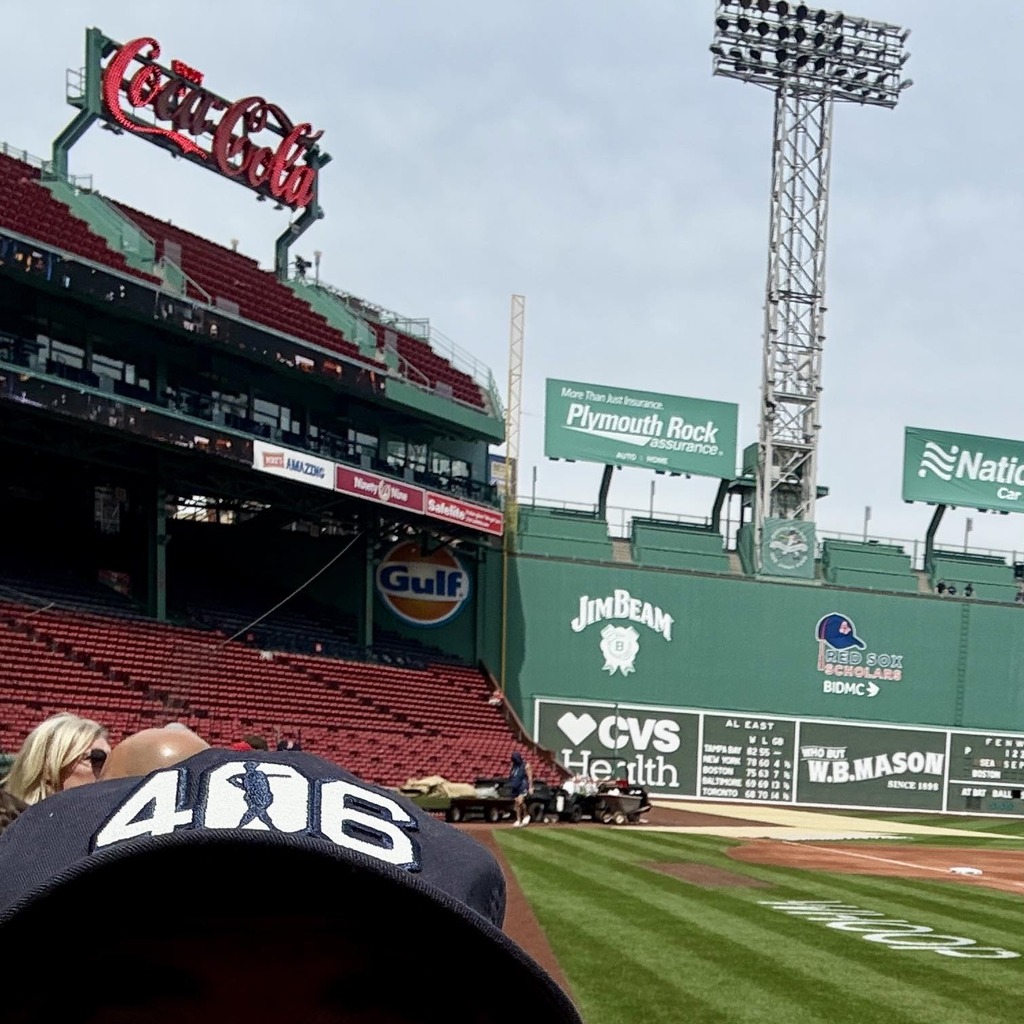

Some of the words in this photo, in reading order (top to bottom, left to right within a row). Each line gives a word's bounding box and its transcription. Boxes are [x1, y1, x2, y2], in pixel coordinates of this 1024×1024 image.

[103, 37, 324, 207] Coca-Cola
[561, 387, 584, 400] More
[585, 390, 606, 402] Than
[606, 393, 624, 405] Just
[566, 403, 663, 437] Plymouth
[667, 416, 719, 443] Rock
[650, 437, 719, 455] assurance
[997, 487, 1022, 501] Car
[380, 565, 464, 597] Gulf
[825, 649, 863, 665] RED
[866, 653, 903, 669] SOX
[824, 664, 902, 681] SCHOLARS
[823, 680, 865, 696] BIDMC
[598, 715, 681, 753] CVS
[725, 719, 740, 729] AL
[744, 720, 775, 731] EAST
[801, 747, 825, 759] WHO
[826, 748, 846, 759] BUT
[702, 765, 734, 776] BOSTON
[887, 780, 917, 790] SINCE
[94, 760, 418, 866] 406
